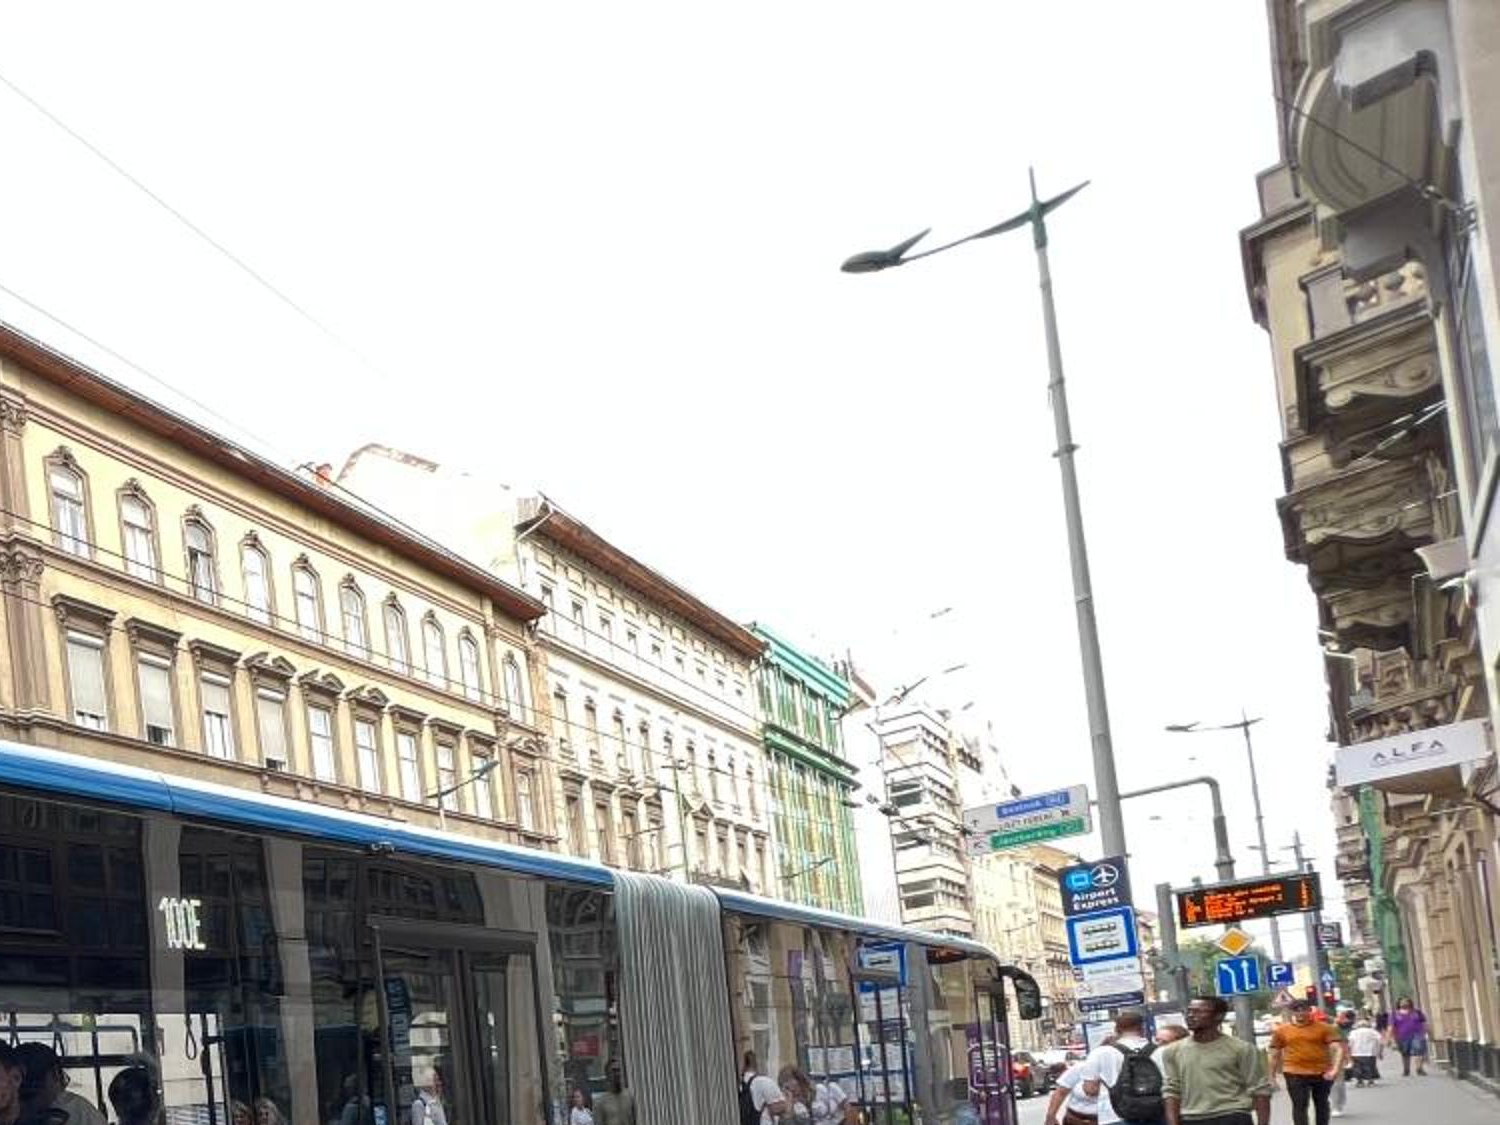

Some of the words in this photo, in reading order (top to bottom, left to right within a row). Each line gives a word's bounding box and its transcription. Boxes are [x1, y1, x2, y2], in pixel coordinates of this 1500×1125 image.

[1372, 739, 1445, 763] ALFA
[1072, 887, 1116, 902] Airport
[1073, 896, 1119, 911] Express
[158, 896, 206, 950] 100E
[1271, 965, 1287, 981] P
